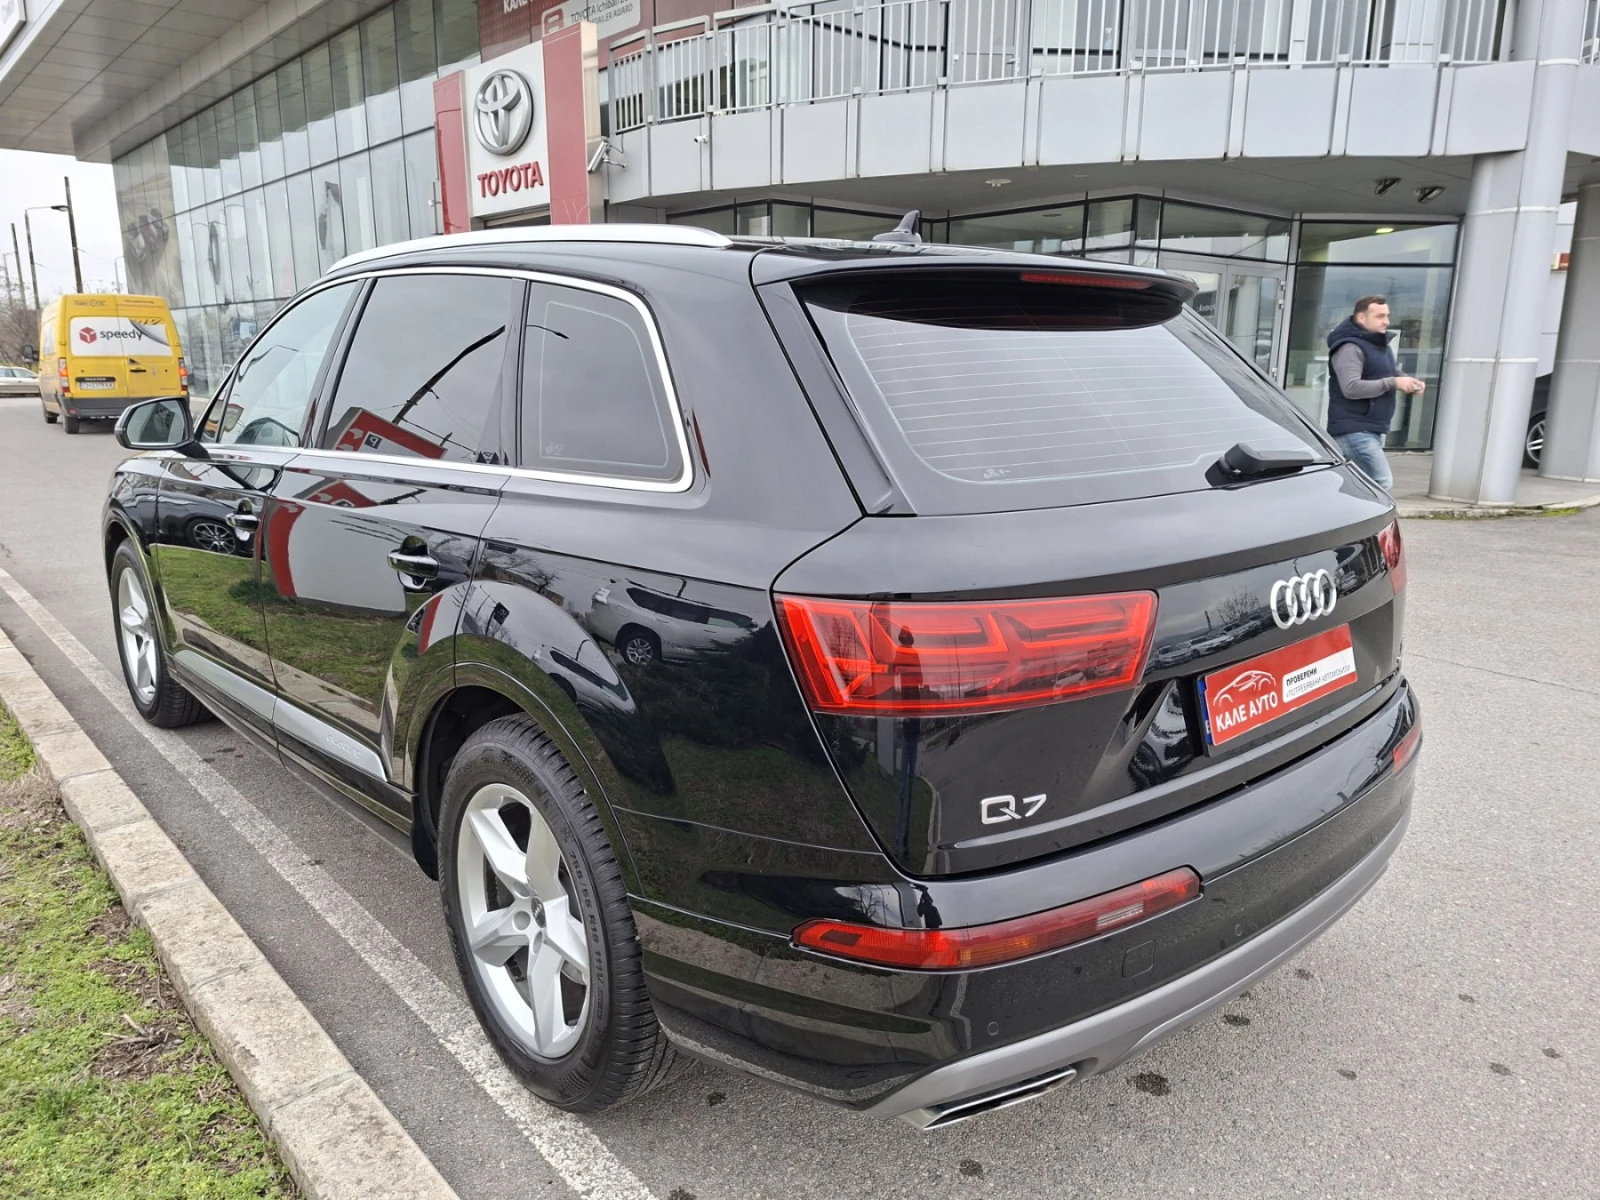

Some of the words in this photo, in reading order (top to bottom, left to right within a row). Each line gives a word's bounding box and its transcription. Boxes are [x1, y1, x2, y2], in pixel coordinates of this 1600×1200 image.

[570, 4, 596, 24] TOYOTA
[477, 160, 544, 198] TOYOTA
[100, 329, 143, 341] speedy
[1286, 667, 1317, 687] ПРОВЕРЕНИ
[1216, 704, 1247, 733] КАЛЕ
[1250, 691, 1278, 718] АУТО
[981, 793, 1047, 825] Q7
